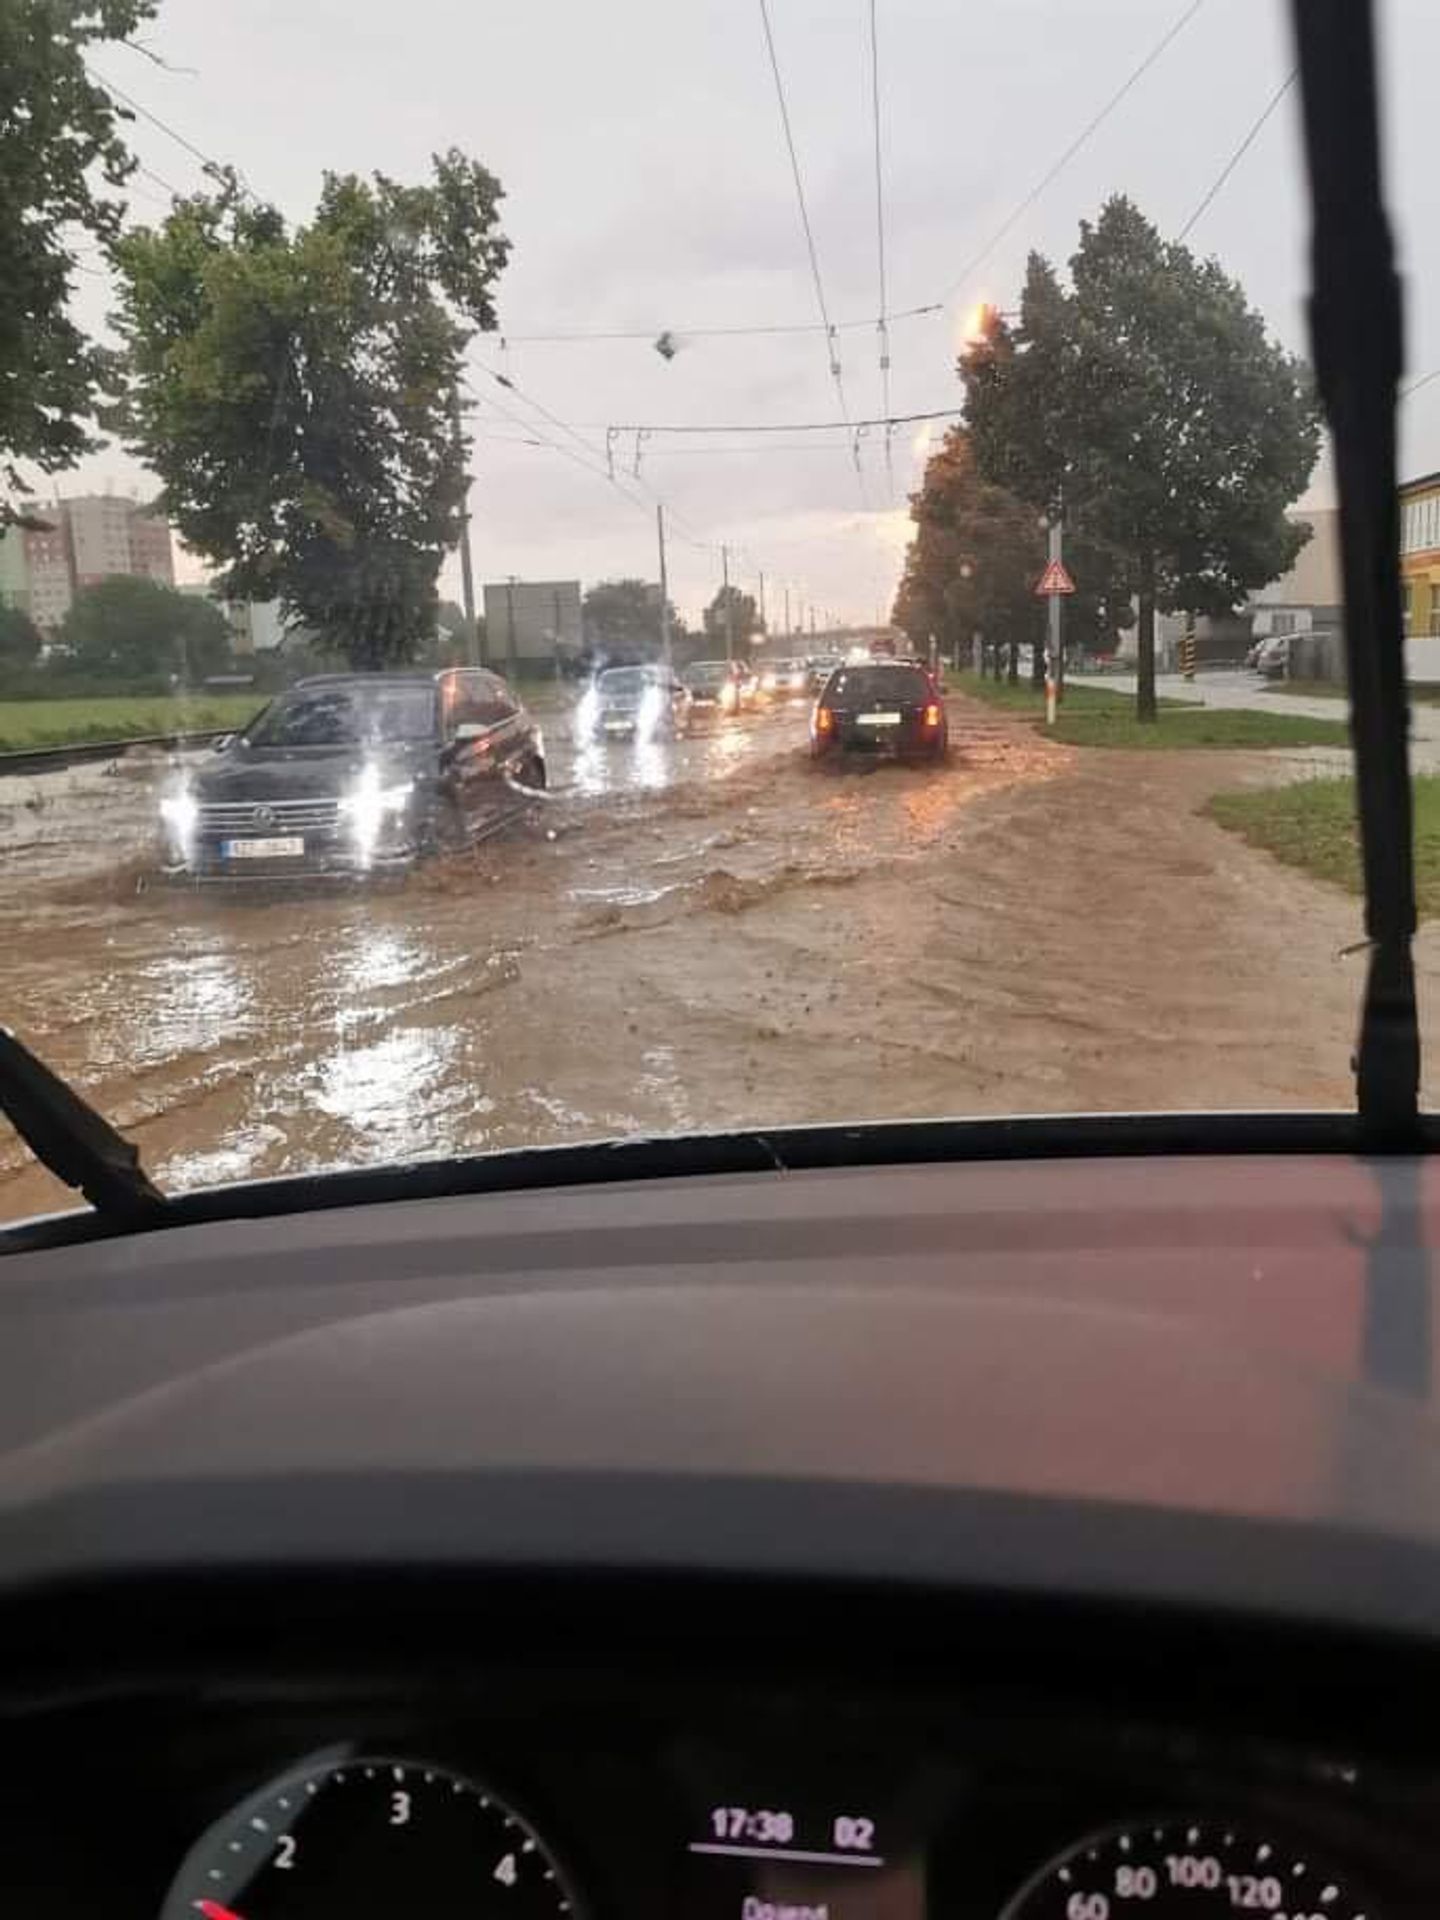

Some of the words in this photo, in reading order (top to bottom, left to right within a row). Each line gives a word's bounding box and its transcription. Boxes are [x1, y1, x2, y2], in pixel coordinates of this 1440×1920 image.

[390, 1791, 411, 1825] 3
[274, 1834, 297, 1869] 2
[493, 1853, 518, 1887] 4
[1115, 1865, 1157, 1899] 80
[1165, 1855, 1221, 1889] 100
[1066, 1892, 1110, 1920] 60
[1226, 1875, 1282, 1910] 120
